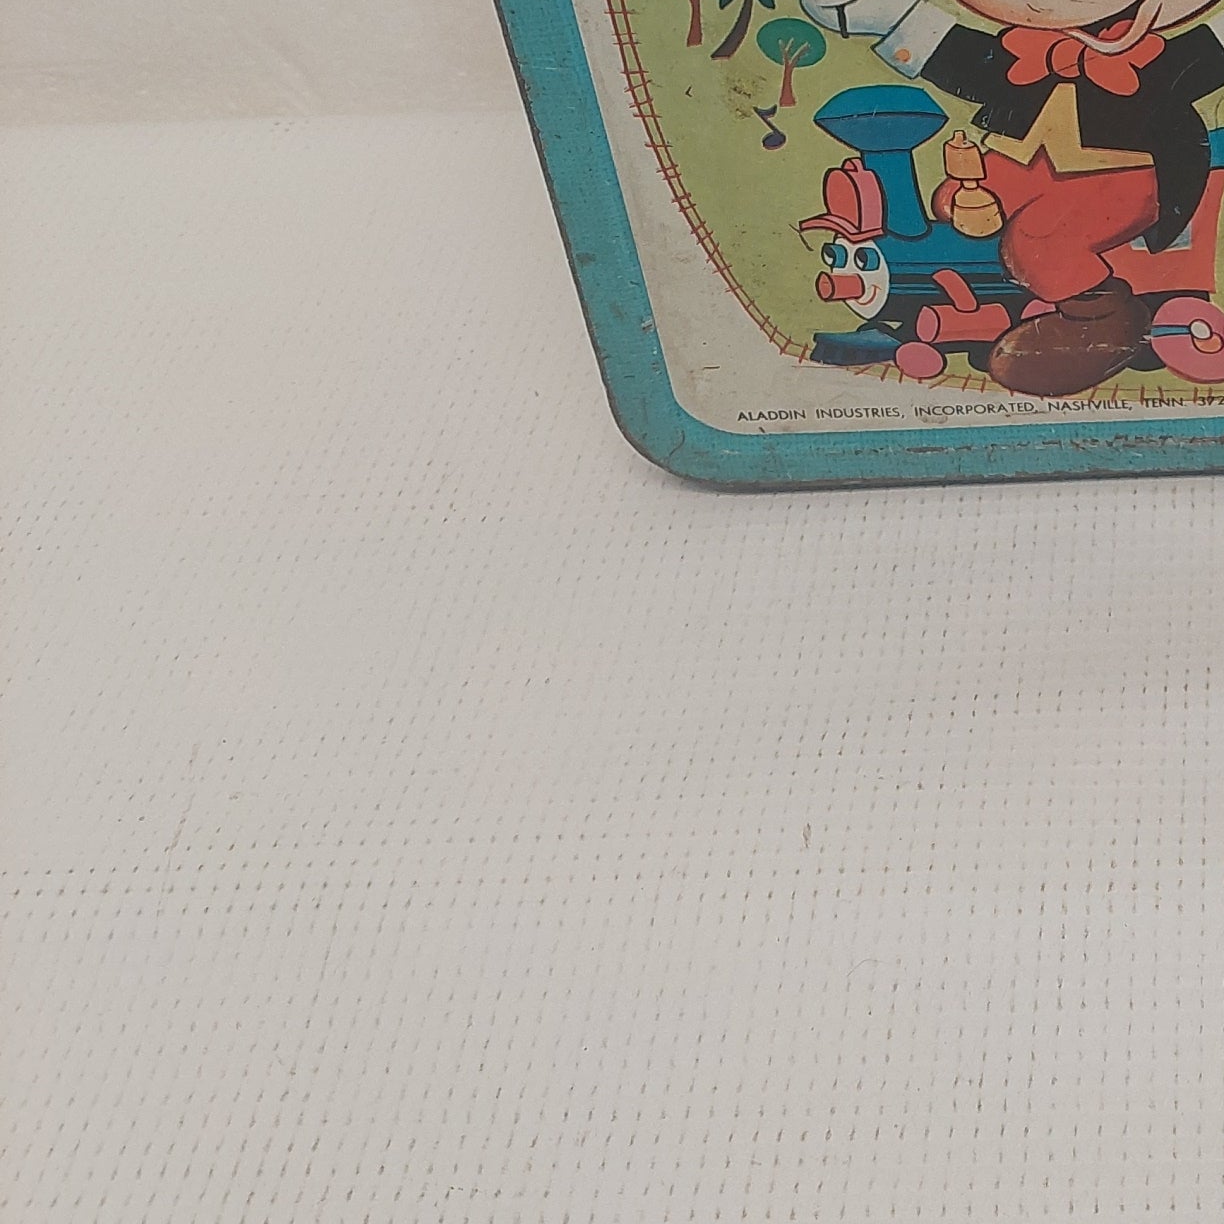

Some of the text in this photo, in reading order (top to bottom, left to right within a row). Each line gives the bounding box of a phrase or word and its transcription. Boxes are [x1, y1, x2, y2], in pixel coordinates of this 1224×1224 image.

[737, 408, 806, 422] ALADDIN
[815, 406, 905, 419] INDUSTRIES,
[914, 402, 1039, 417] INCORPORATED,
[1047, 399, 1133, 413] NASHVILLE,
[1143, 397, 1187, 409] TENN.
